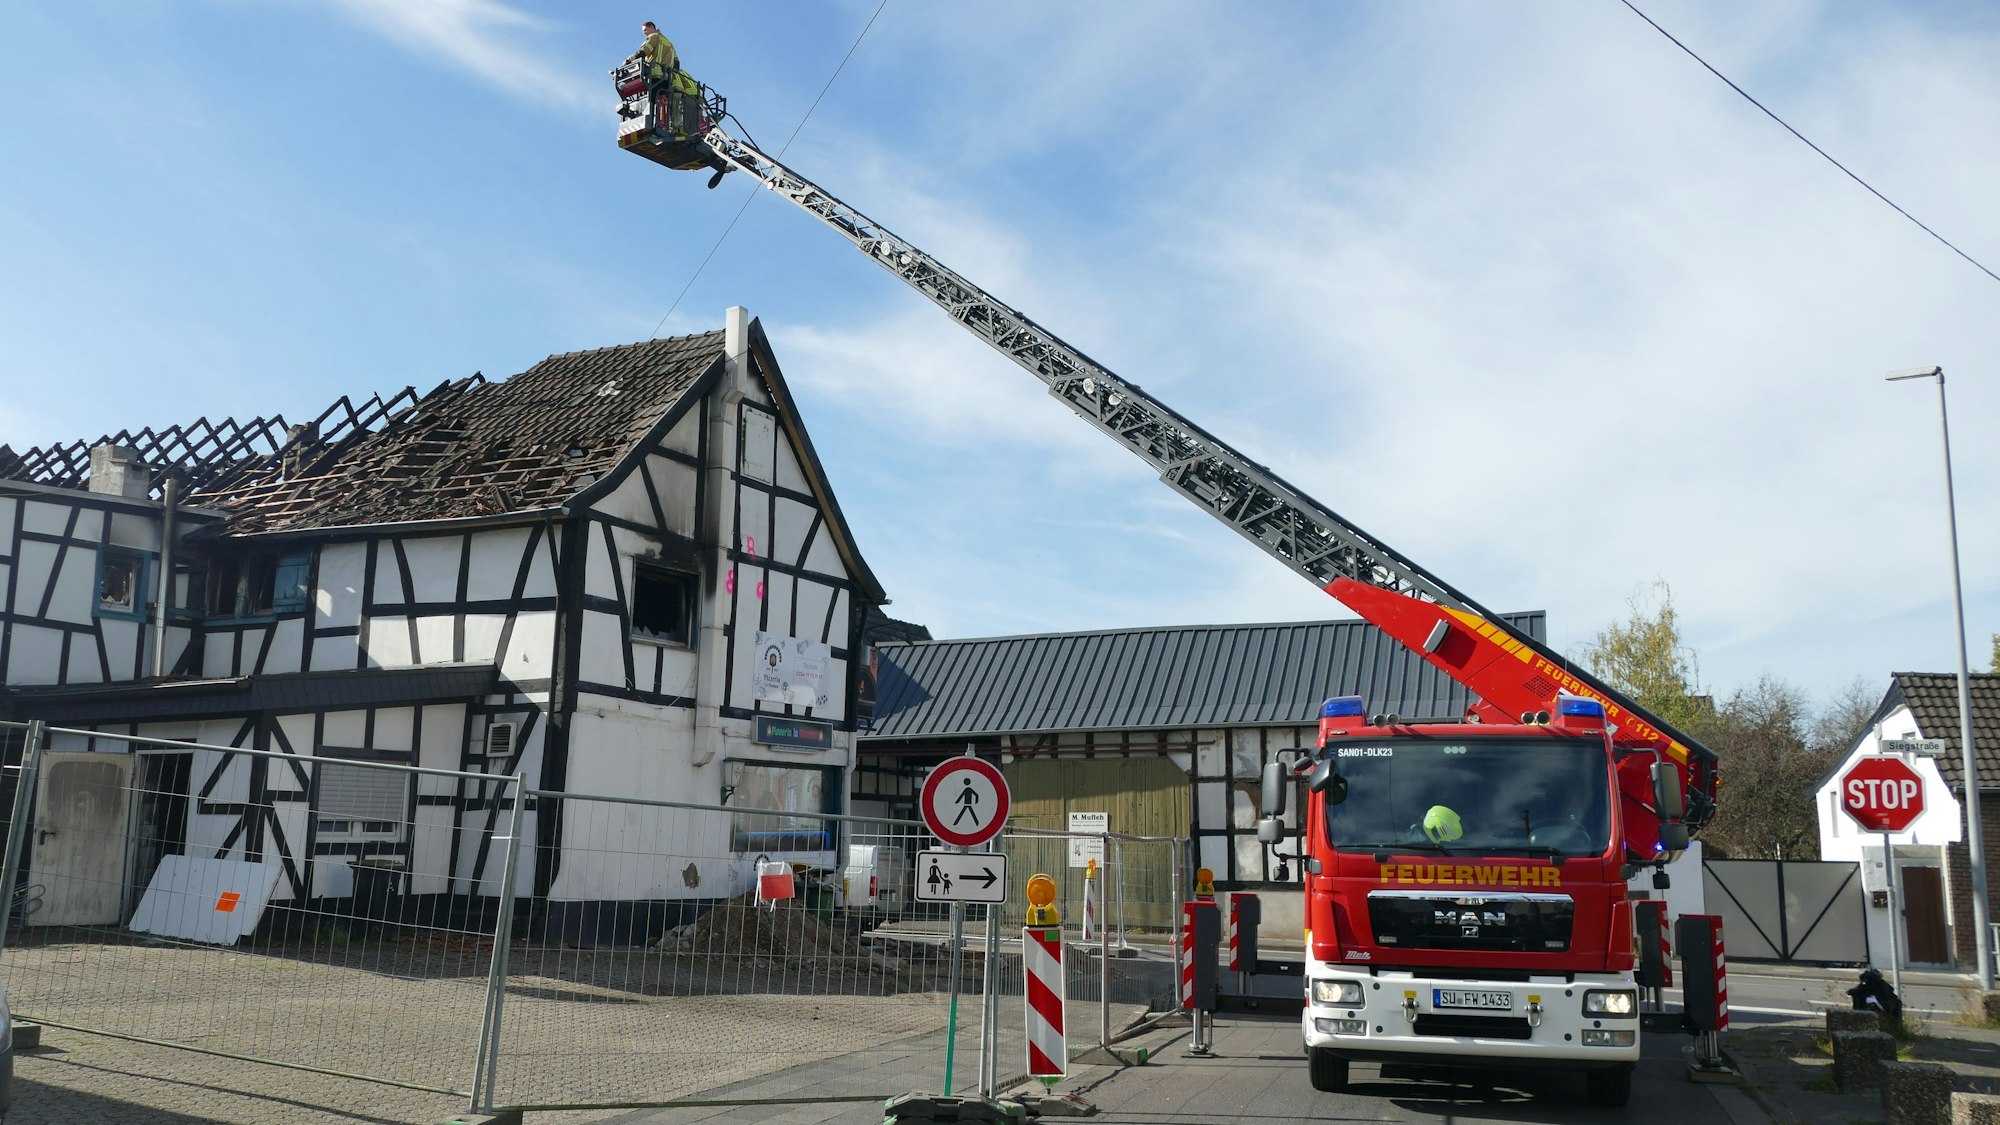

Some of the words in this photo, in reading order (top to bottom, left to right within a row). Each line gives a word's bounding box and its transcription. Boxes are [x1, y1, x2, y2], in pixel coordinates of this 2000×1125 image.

[1635, 722, 1660, 743] 112
[1338, 748, 1393, 757] SAN01-DLK23
[1889, 742, 1940, 752] Siegstraße
[1847, 779, 1918, 810] STOP
[1381, 865, 1560, 887] FEUERWEHR
[1434, 910, 1506, 926] MAN
[1442, 991, 1456, 1004] SU
[1464, 993, 1478, 1005] FW
[1482, 994, 1509, 1006] 1433
